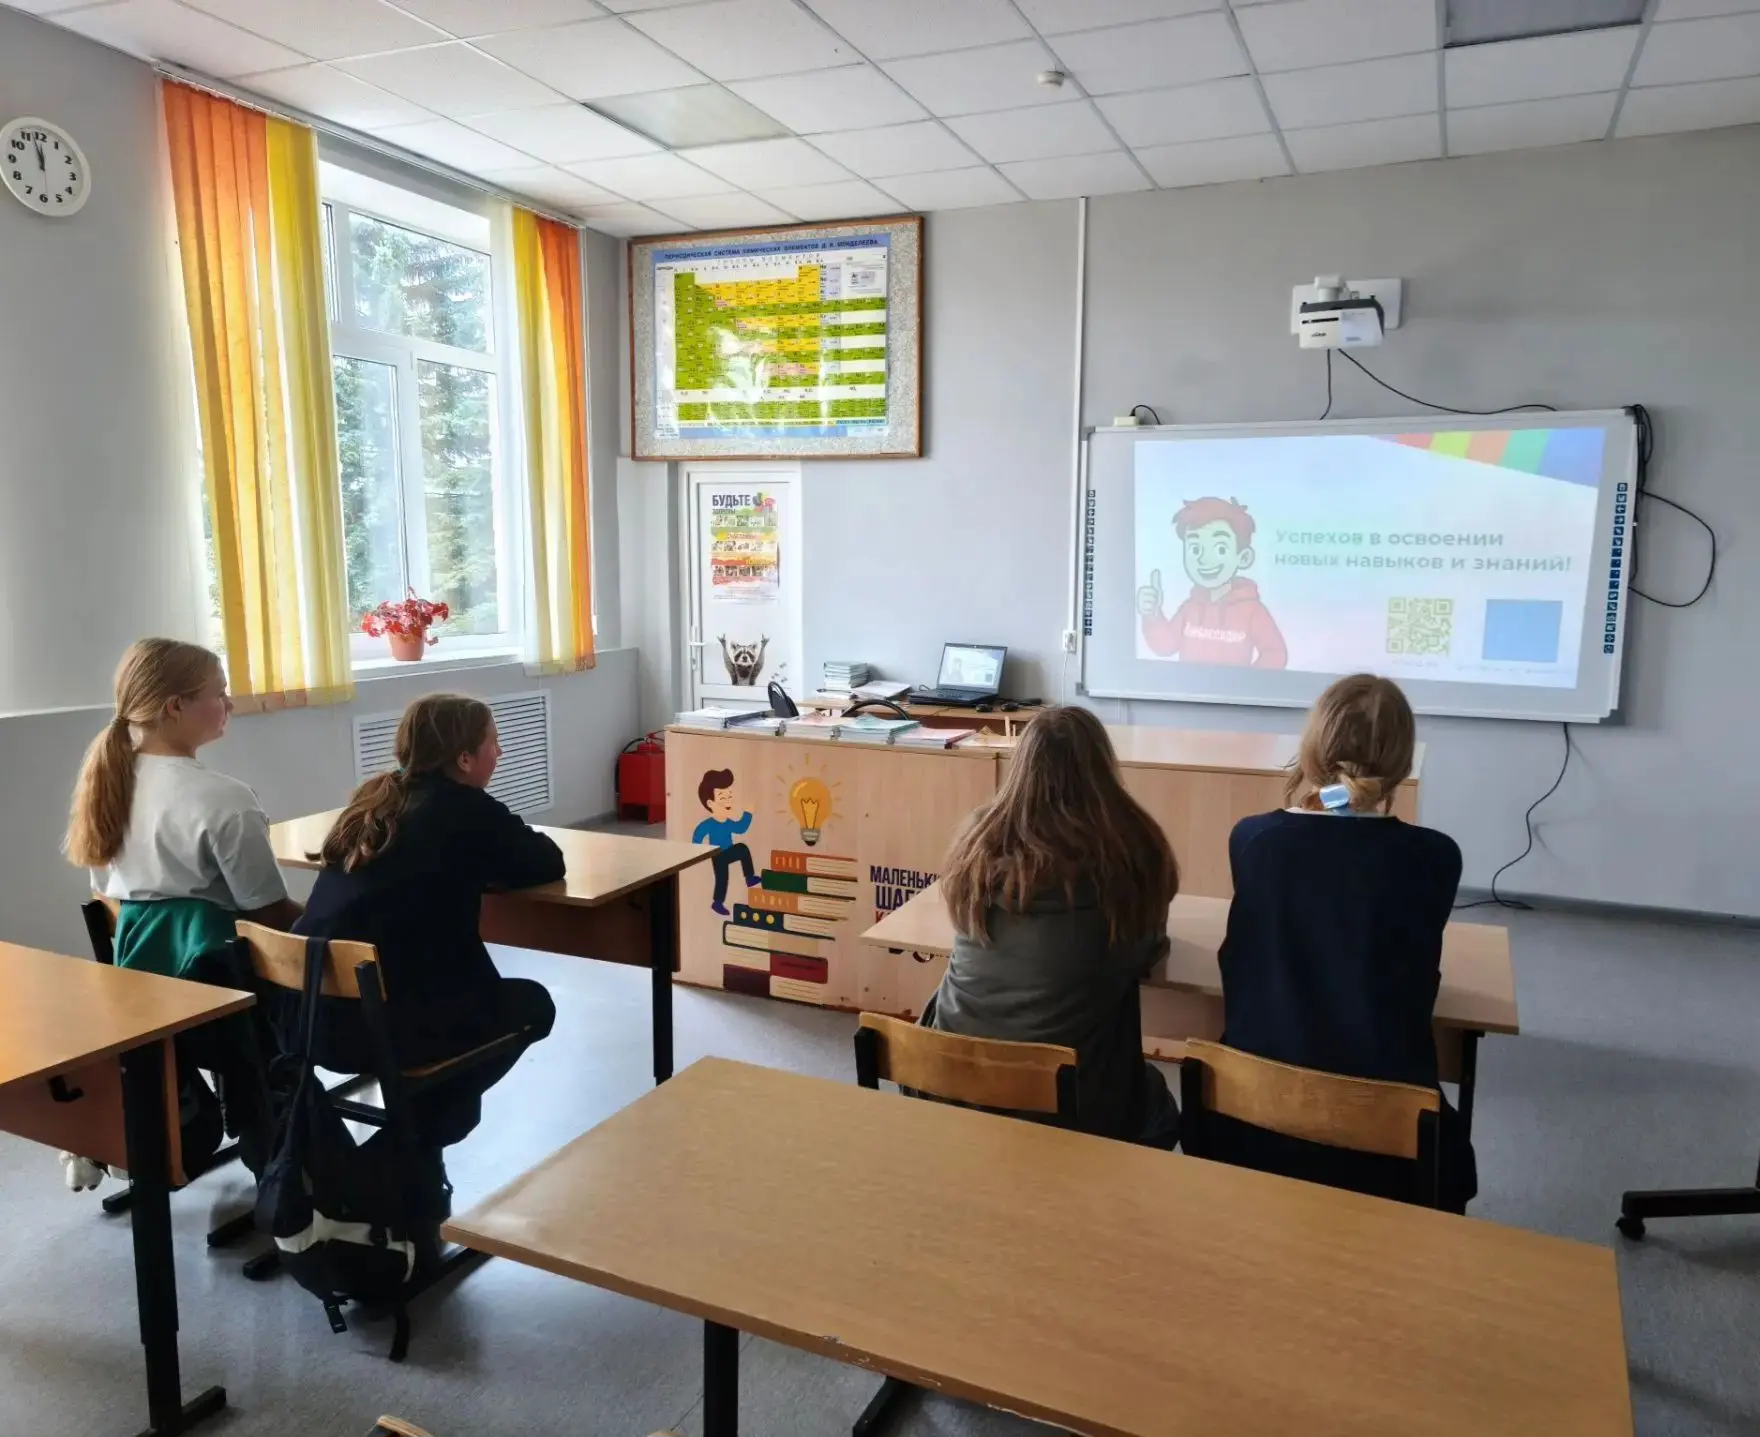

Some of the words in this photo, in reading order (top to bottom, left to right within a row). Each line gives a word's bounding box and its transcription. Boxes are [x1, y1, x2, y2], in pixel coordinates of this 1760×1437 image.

[20, 131, 31, 141] 11
[34, 131, 47, 143] 12
[11, 139, 25, 150] 10
[54, 141, 59, 150] 1
[8, 154, 17, 163] 9
[64, 155, 72, 165] 2
[13, 171, 22, 180] 8
[69, 172, 77, 181] 3
[25, 185, 33, 194] 7
[65, 186, 73, 195] 4
[39, 194, 48, 203] 6
[56, 194, 63, 203] 5
[713, 248, 741, 257] СИСТЕМА
[712, 494, 751, 508] БУДЬТЕ
[1275, 528, 1364, 546] Успехов
[1387, 531, 1504, 547] освоении
[1274, 553, 1340, 567] новых
[1345, 554, 1444, 570] навыков
[1450, 557, 1466, 570] и
[1472, 554, 1572, 573] знаний!
[875, 885, 922, 911] ШАГ
